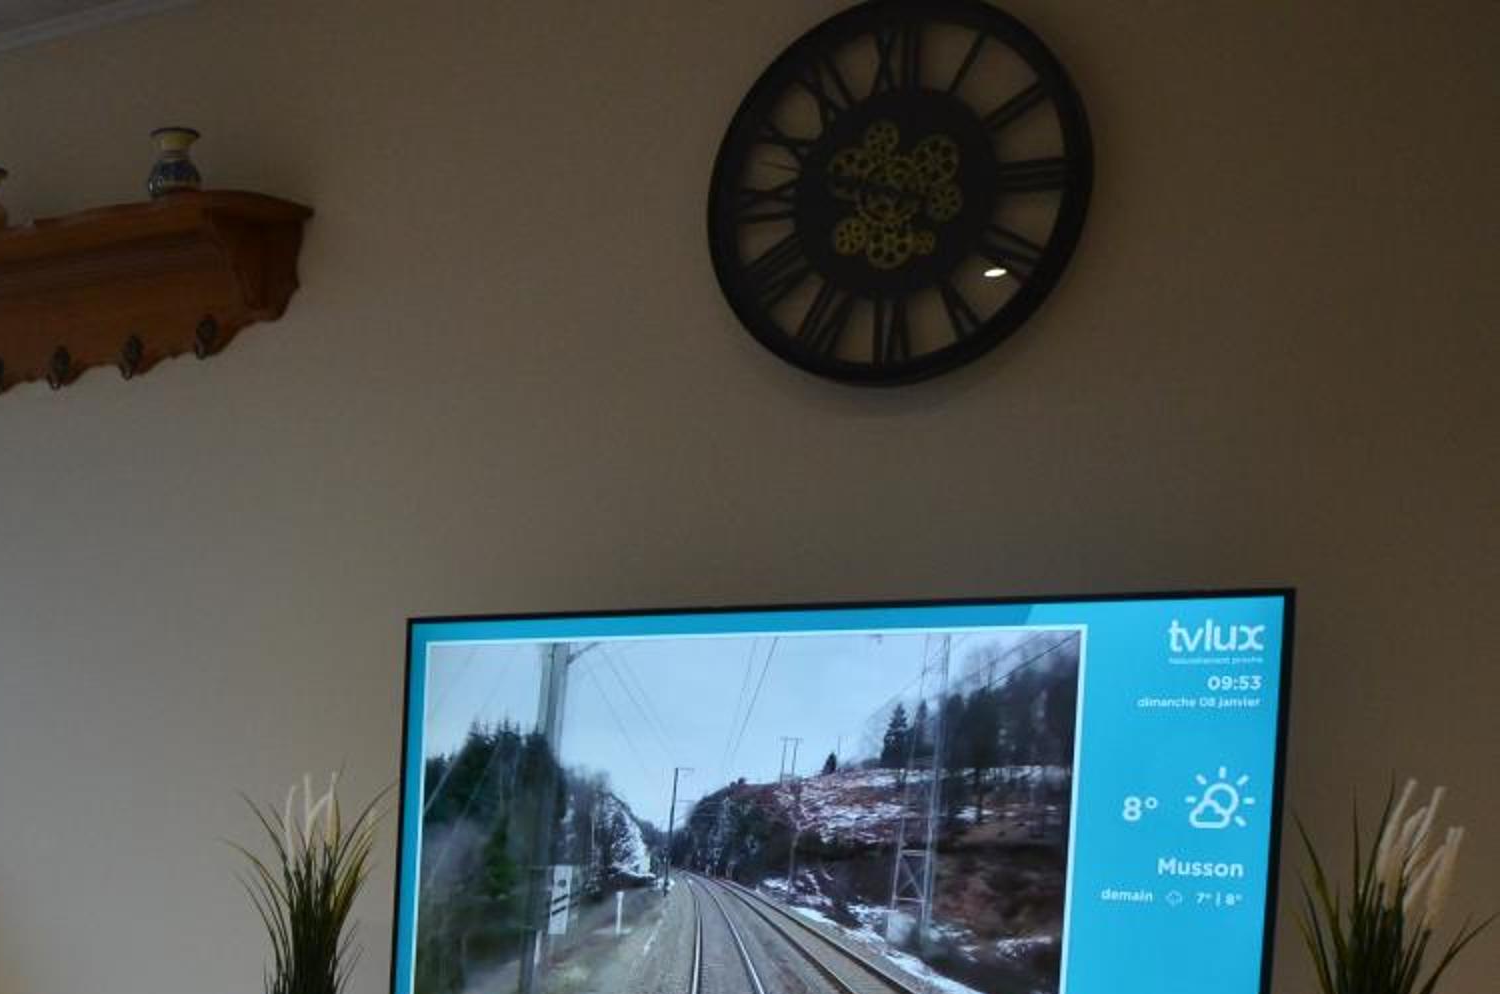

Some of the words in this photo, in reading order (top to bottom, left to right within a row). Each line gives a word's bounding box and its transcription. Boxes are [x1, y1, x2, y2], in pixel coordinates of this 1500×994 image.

[1168, 619, 1265, 652] tvlux
[1207, 675, 1262, 690] 09:53
[1137, 697, 1197, 708] dimanche
[1199, 697, 1215, 708] 08
[1217, 697, 1260, 708] janvier
[1122, 796, 1158, 822] 8°
[1157, 858, 1244, 878] Musson
[1101, 888, 1153, 902] demain
